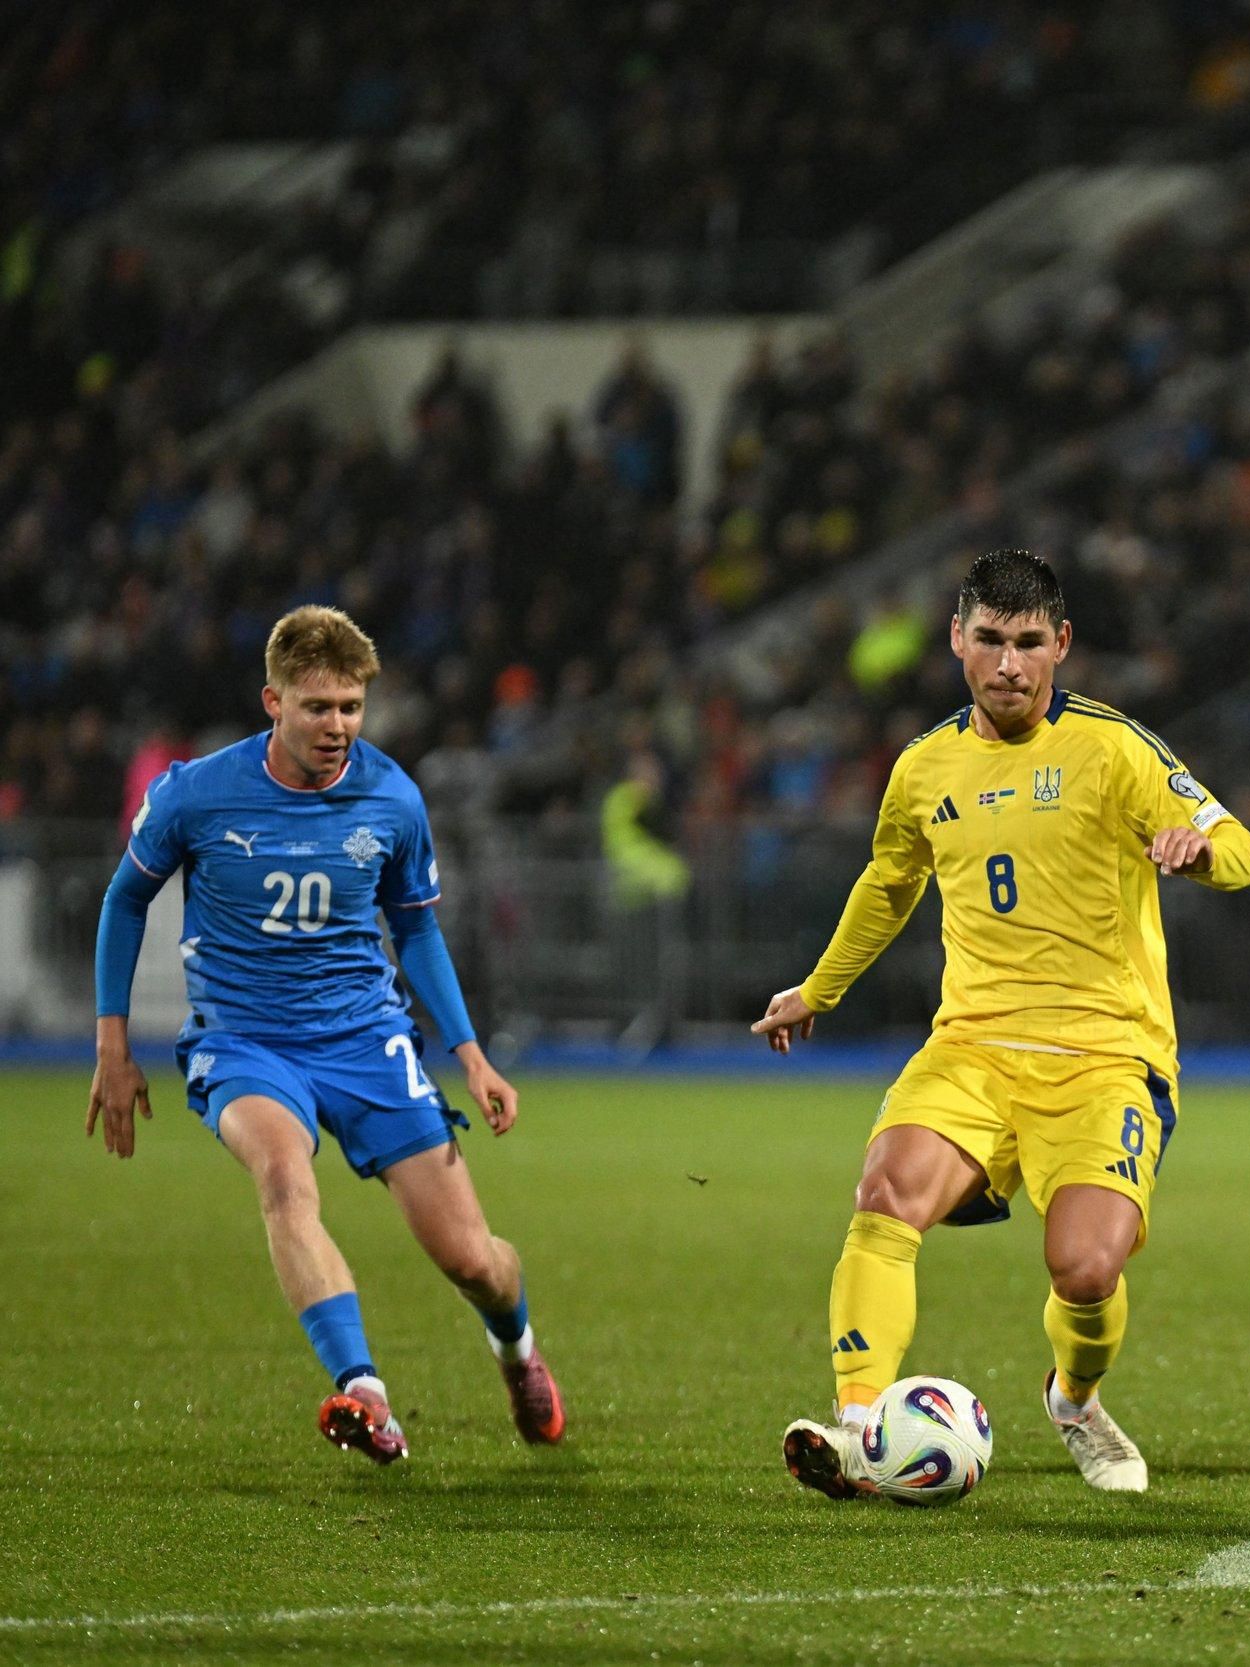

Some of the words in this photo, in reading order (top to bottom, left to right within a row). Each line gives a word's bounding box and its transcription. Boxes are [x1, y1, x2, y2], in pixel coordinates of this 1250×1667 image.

[261, 871, 331, 933] 20
[986, 853, 1018, 914] 8
[385, 1034, 439, 1105] 2
[1121, 1106, 1144, 1156] 8
